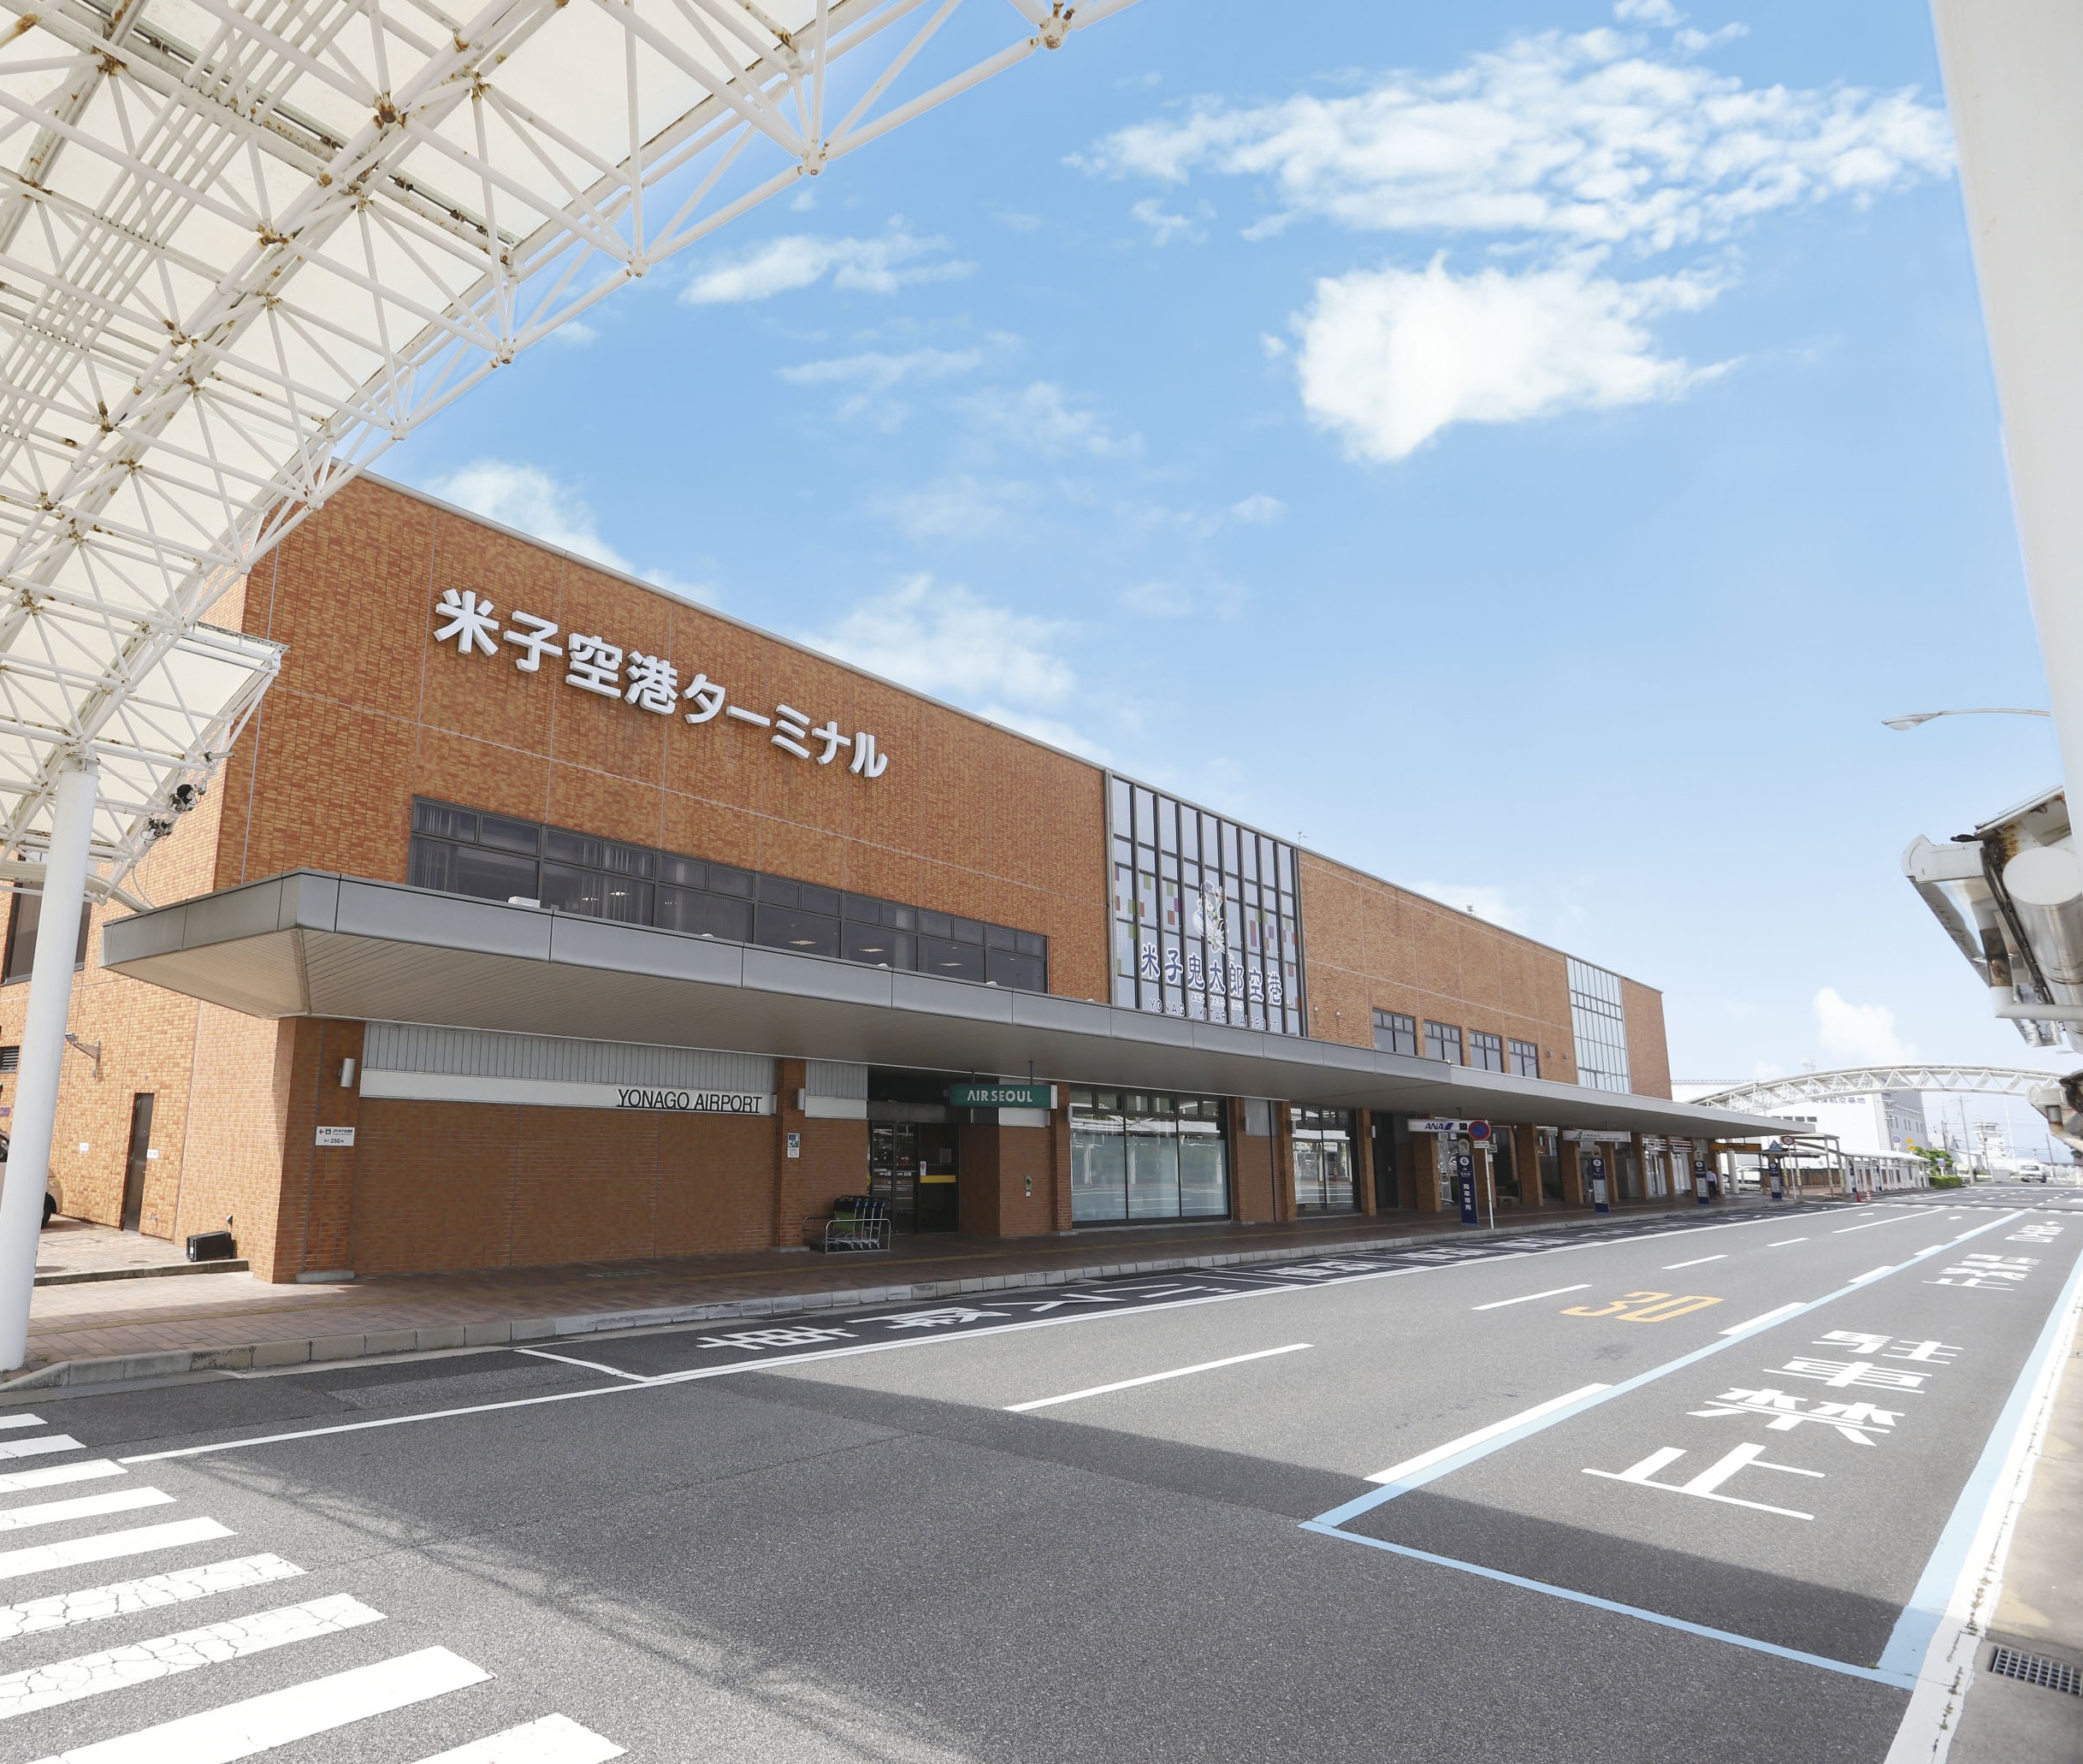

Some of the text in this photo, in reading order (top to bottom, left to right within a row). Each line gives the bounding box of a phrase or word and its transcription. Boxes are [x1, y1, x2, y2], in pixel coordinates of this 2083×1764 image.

[434, 588, 889, 778] 米子空港ターミナル
[1141, 942, 1283, 1005] 米子鬼太郎空港
[617, 1089, 762, 1113] YONAGO AIRPORT
[967, 1090, 1033, 1104] AIR SEOUL
[1559, 1291, 1725, 1323] 30
[1581, 1329, 1965, 1521] 駐車禁止
